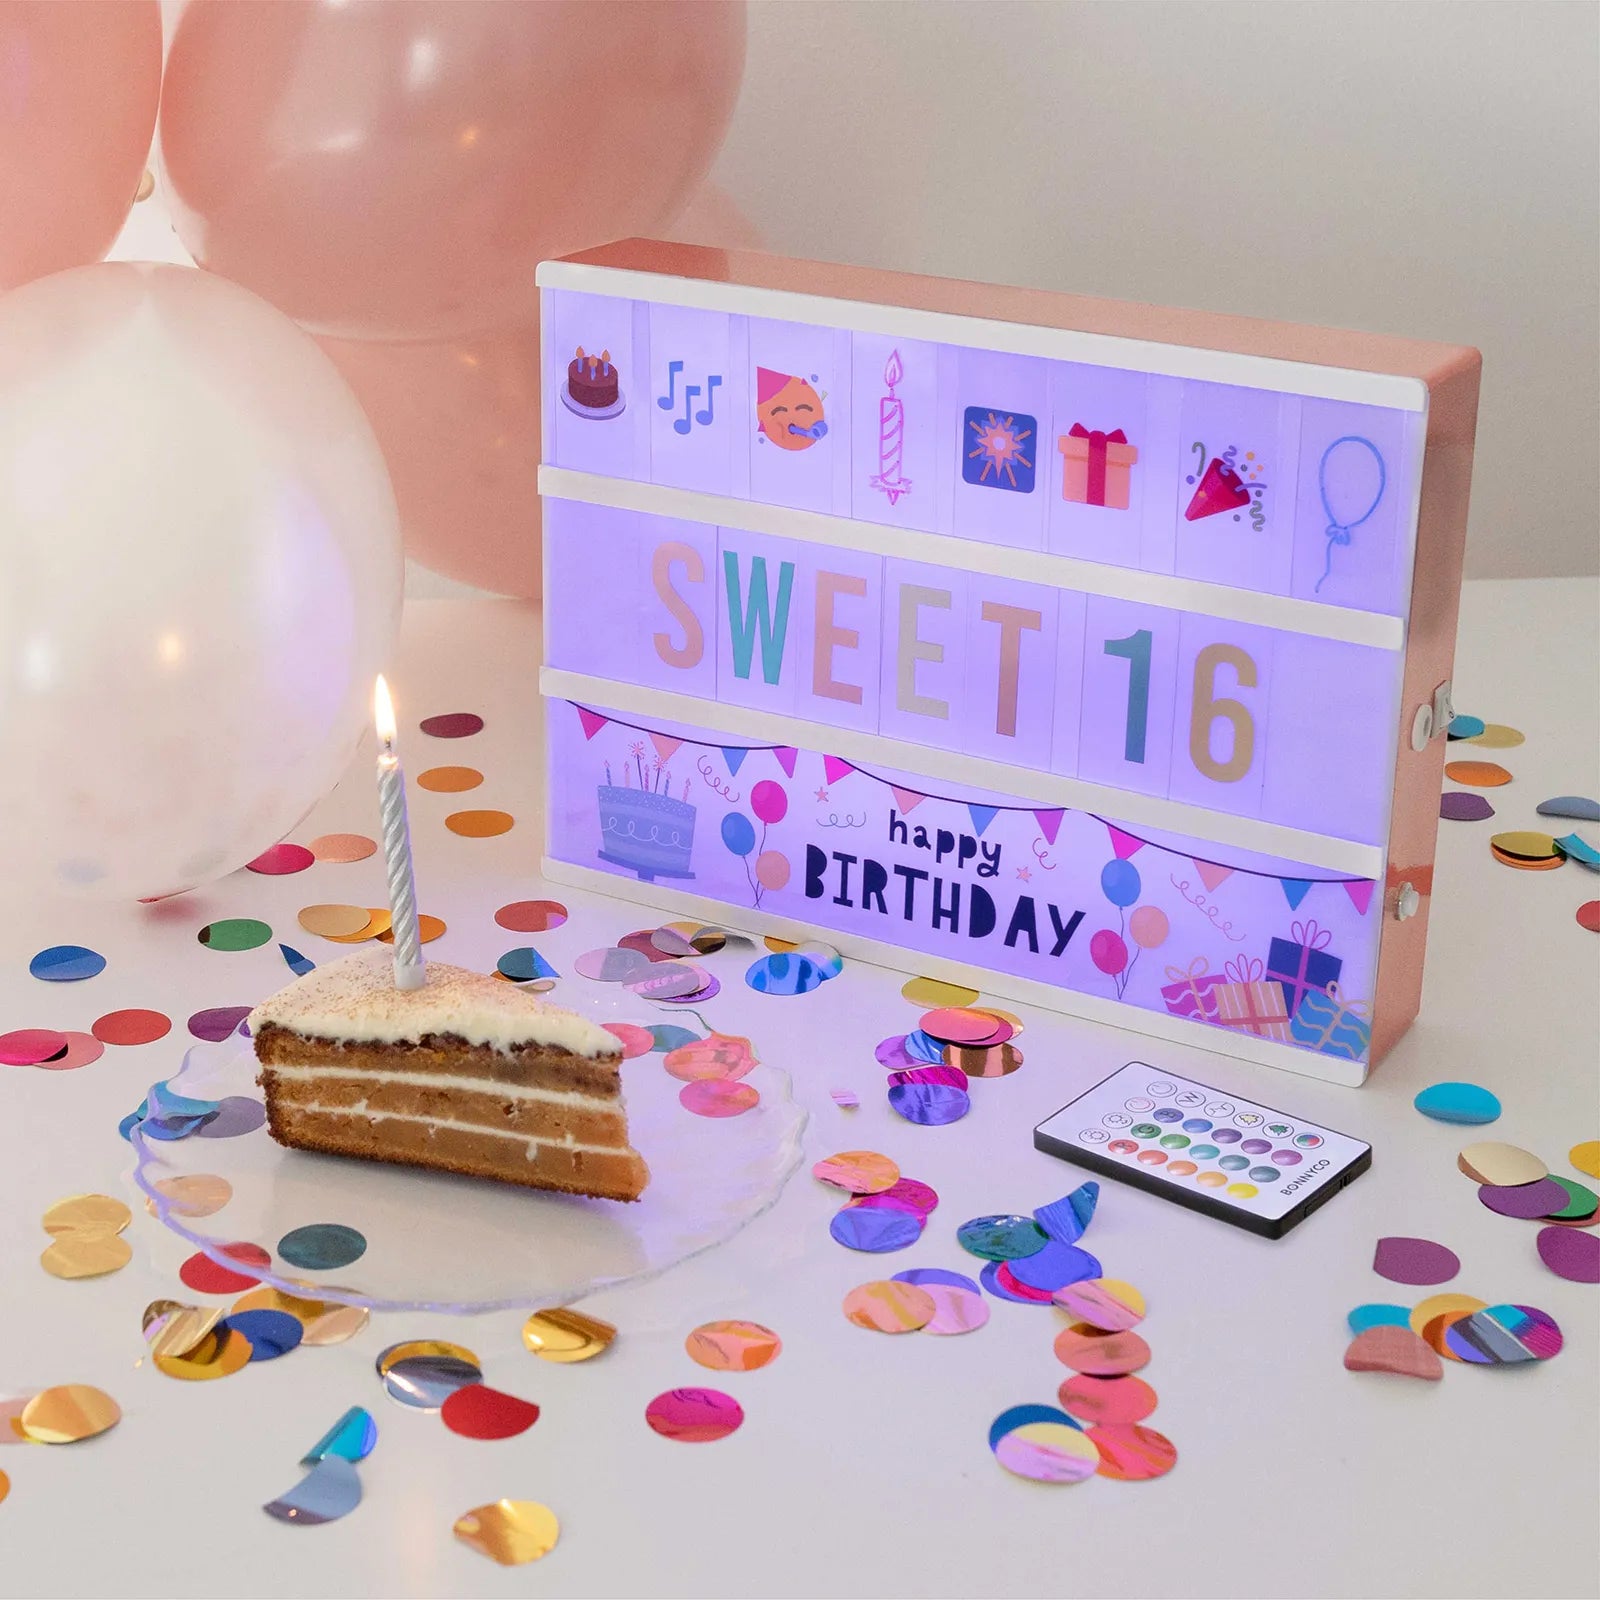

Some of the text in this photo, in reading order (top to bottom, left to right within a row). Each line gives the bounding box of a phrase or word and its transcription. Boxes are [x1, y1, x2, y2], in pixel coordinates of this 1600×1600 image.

[651, 540, 1258, 784] SWEET 16
[889, 808, 1002, 878] happy
[804, 843, 1087, 958] BIRTHDAY
[1280, 1159, 1330, 1196] BONNYCO
